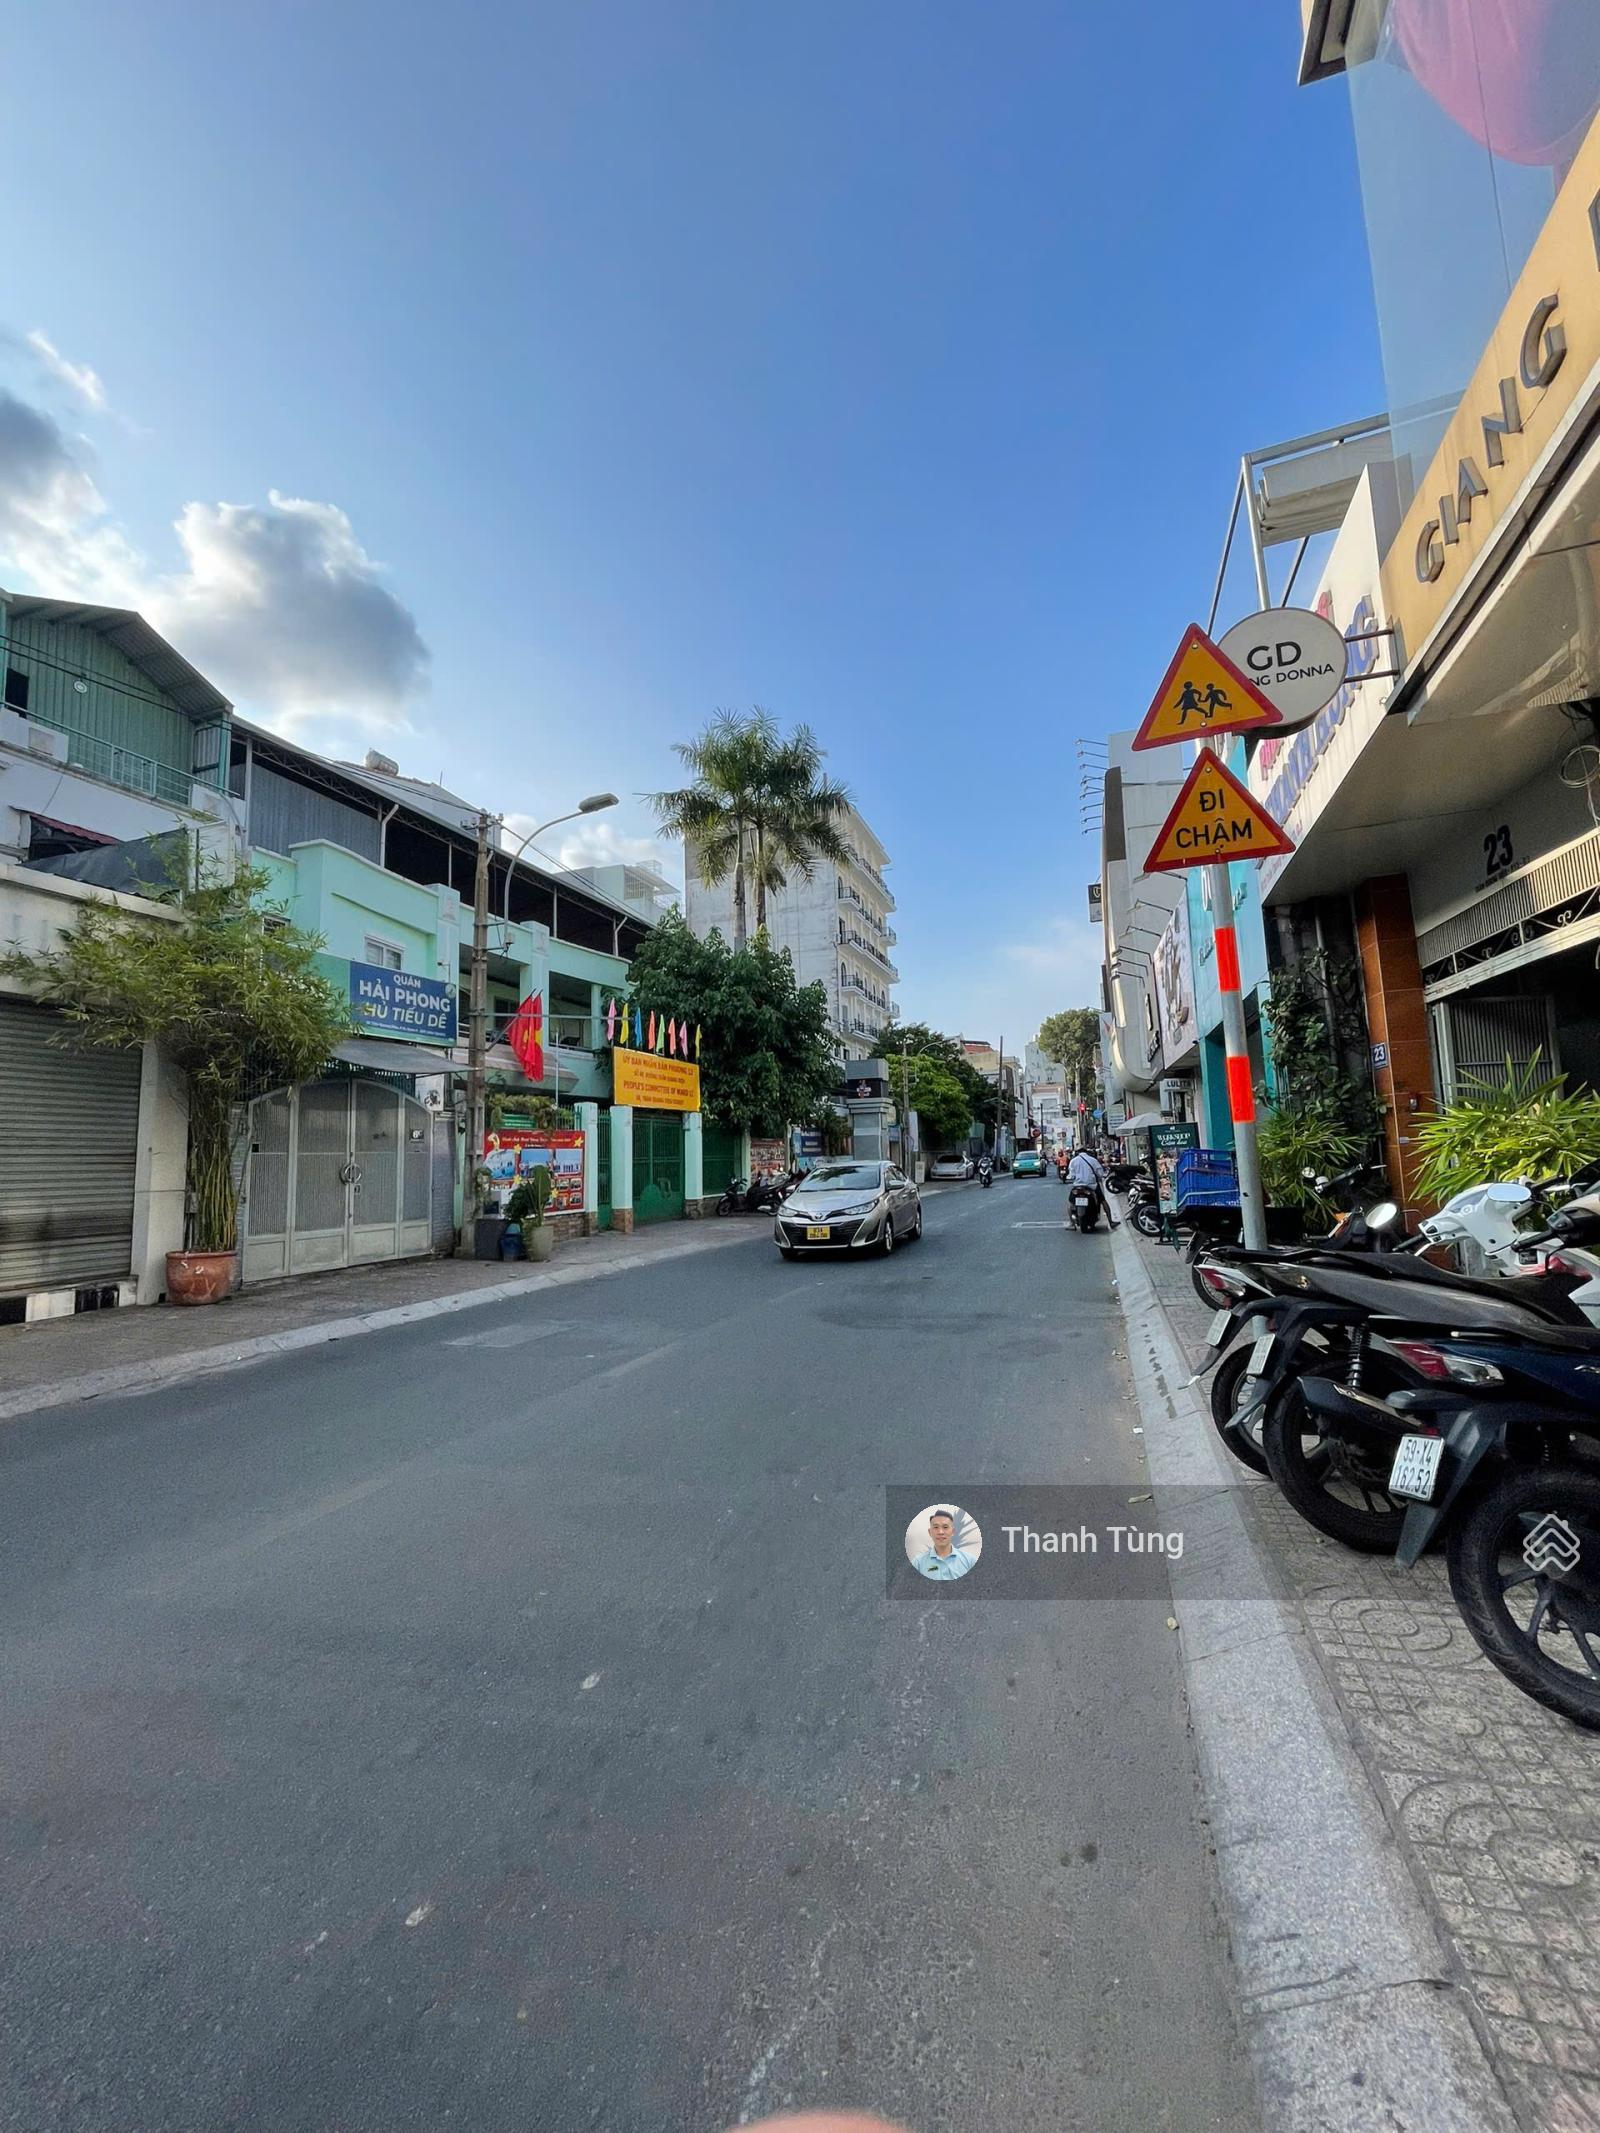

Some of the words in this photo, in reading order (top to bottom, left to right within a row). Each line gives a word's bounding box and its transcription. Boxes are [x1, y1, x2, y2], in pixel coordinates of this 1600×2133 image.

[1415, 293, 1567, 583] GIANG
[1246, 641, 1302, 671] GD
[1276, 663, 1335, 683] DONNA
[1199, 788, 1225, 812] ĐI
[1176, 817, 1252, 849] CHẬM
[1483, 823, 1513, 876] 23
[359, 978, 390, 1001] HẢI
[395, 987, 451, 1012] PHONG
[392, 1006, 425, 1025] TIẾU
[427, 1013, 447, 1029] DÊ
[1373, 1045, 1385, 1062] 23
[1404, 1439, 1433, 1466] 59-X4
